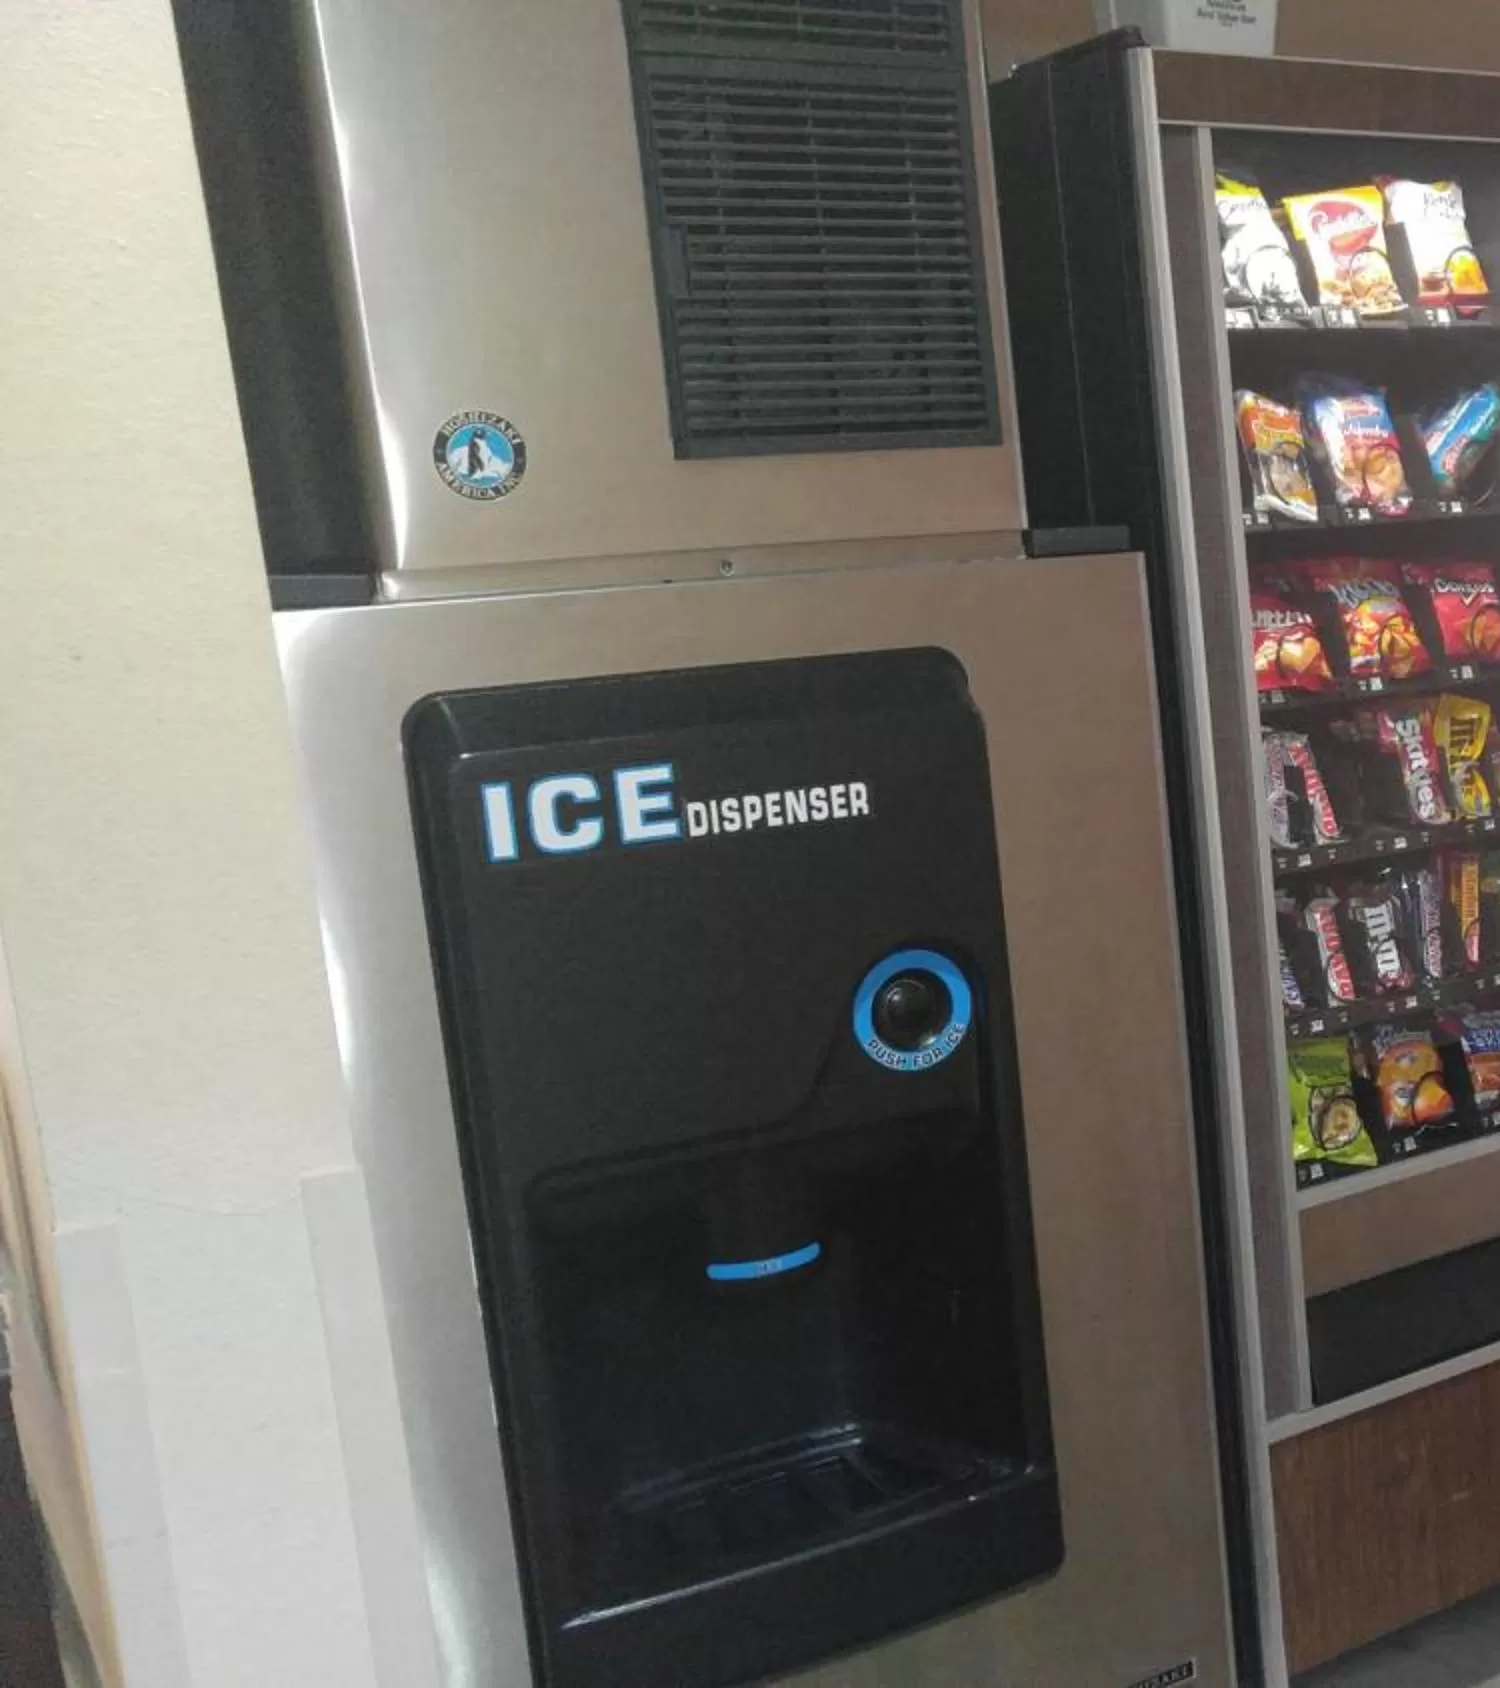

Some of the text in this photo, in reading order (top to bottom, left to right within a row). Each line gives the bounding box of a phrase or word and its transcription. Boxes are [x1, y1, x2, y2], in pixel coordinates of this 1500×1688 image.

[480, 764, 869, 863] ICE DISPENSER
[867, 1022, 967, 1068] PUSH FOR ICE
